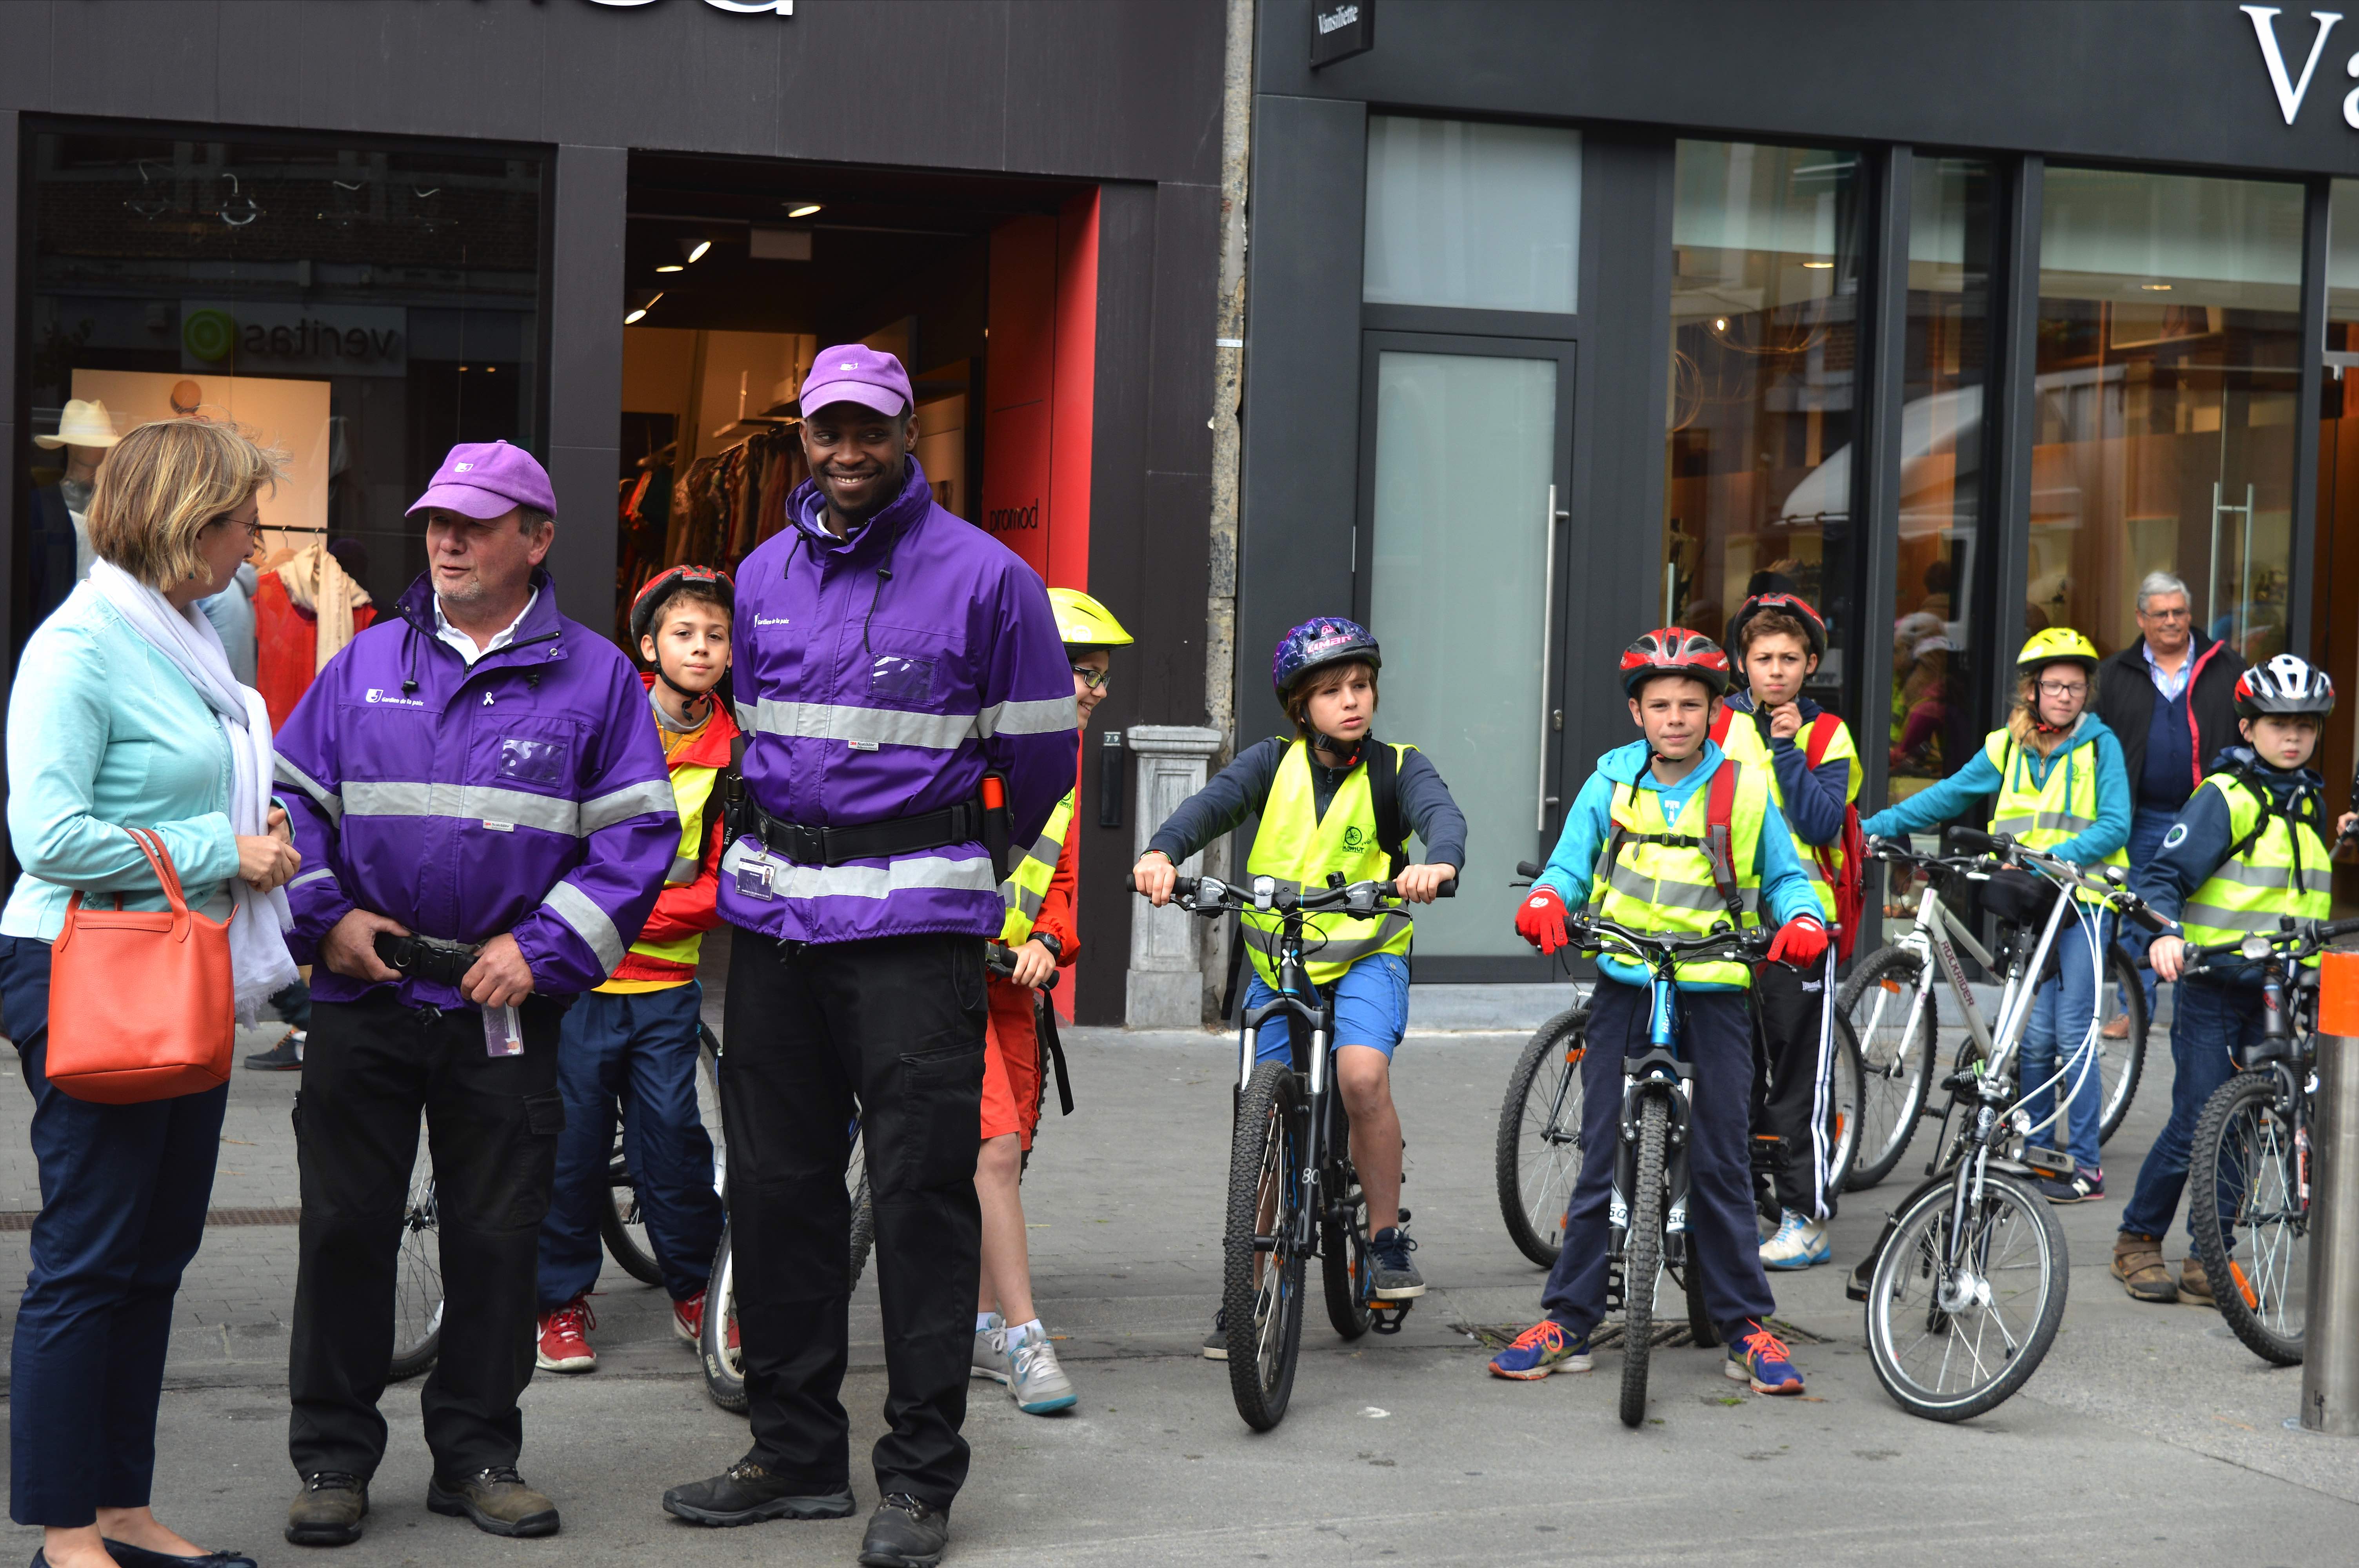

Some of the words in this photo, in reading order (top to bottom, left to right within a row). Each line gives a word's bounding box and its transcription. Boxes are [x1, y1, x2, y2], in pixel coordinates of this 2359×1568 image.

[2239, 4, 2359, 130] V
[990, 498, 1039, 532] promod
[723, 827, 732, 845] POLICE
[1302, 1168, 1320, 1184] 80
